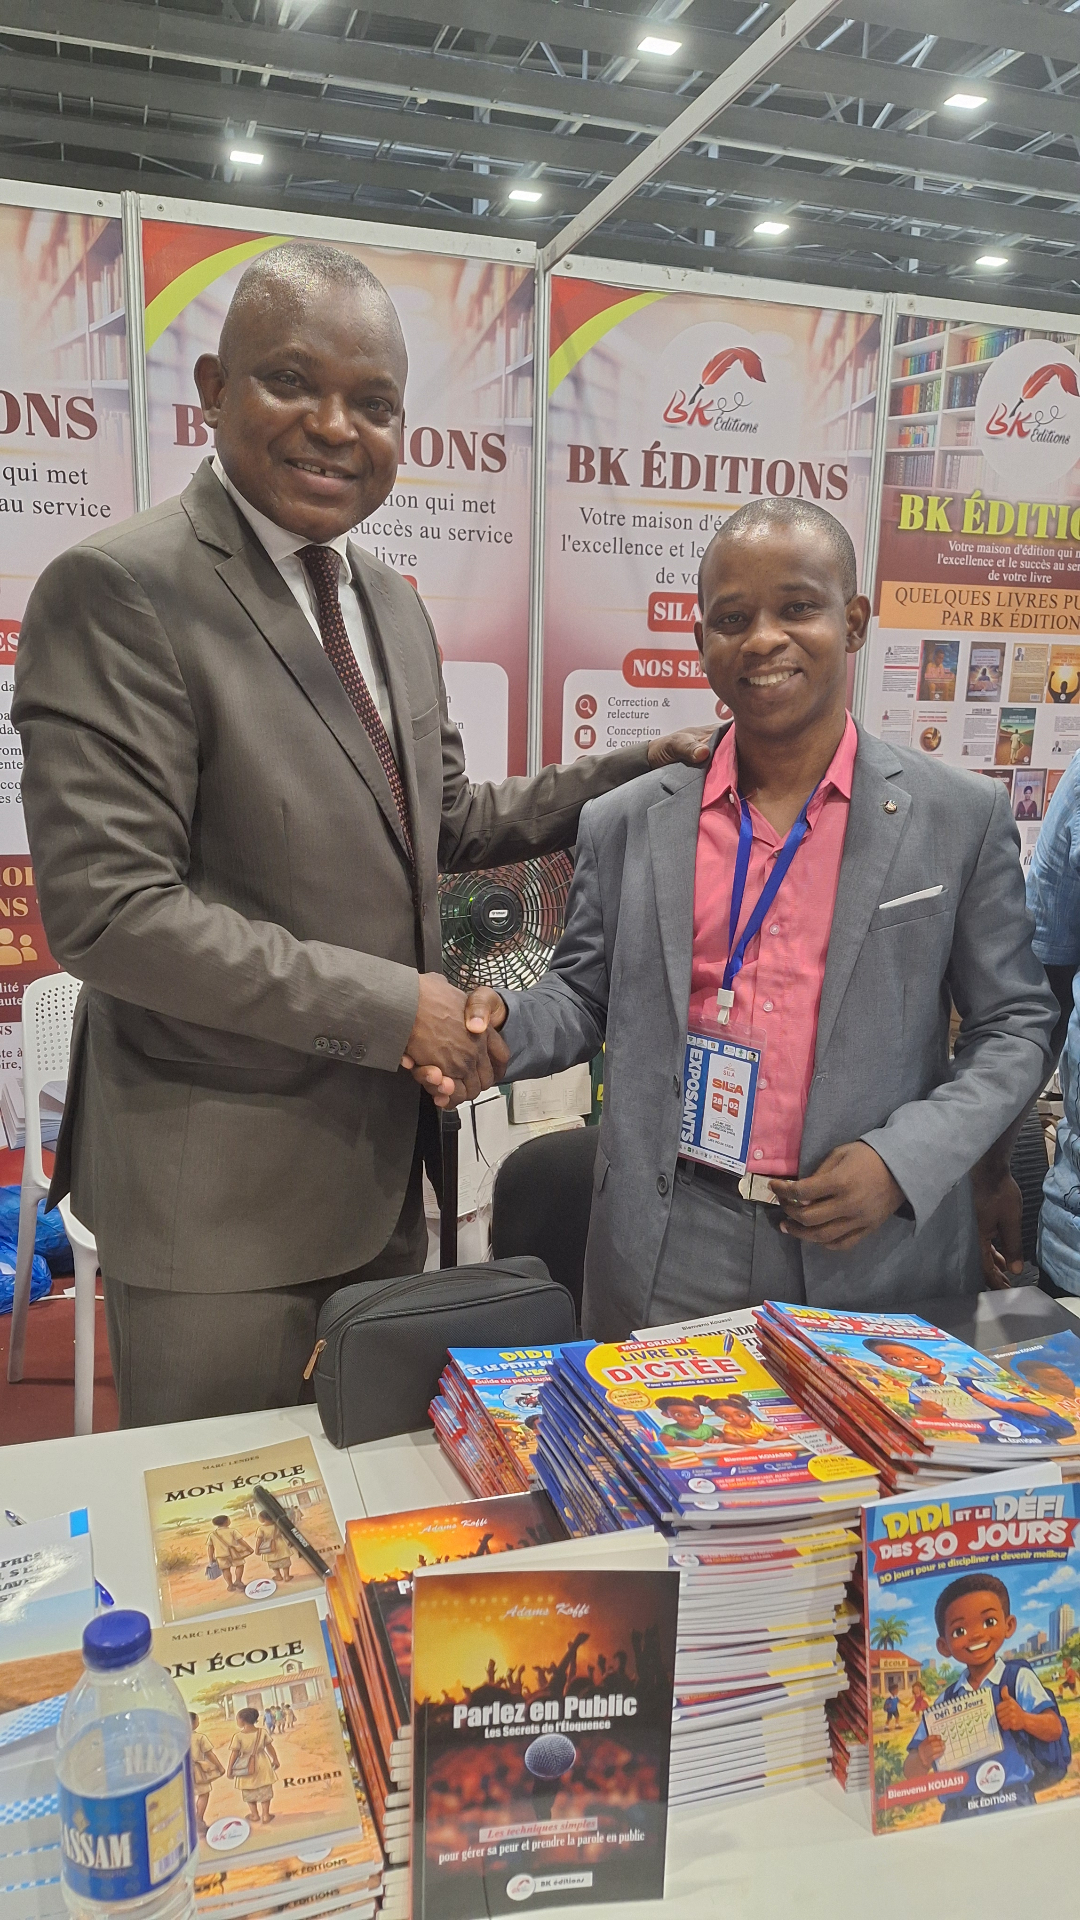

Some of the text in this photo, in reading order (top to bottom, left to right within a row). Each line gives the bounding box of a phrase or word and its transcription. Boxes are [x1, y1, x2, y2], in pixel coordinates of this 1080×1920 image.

[2, 462, 89, 486] qui met
[566, 440, 849, 501] BK ÉDITIONS
[32, 497, 112, 518] service
[425, 494, 455, 515] qui
[463, 499, 497, 515] met
[898, 493, 953, 533] BK
[579, 506, 723, 532] Votre maison d'é
[351, 518, 513, 544] succès au service
[561, 534, 663, 557] l'excellence
[669, 542, 685, 558] et
[948, 540, 1073, 561] Votre maison d'édition qui
[937, 552, 994, 567] l'excellence
[996, 558, 1006, 568] et
[1008, 558, 1018, 569] le
[1019, 558, 1051, 570] succès
[1053, 563, 1065, 572] au
[655, 567, 675, 584] de
[988, 569, 1053, 584] de votre livre
[895, 586, 1058, 609] QUELQUES LIVRES
[941, 609, 975, 627] PAR
[980, 612, 1005, 628] BK
[632, 659, 708, 678] NOS SE
[607, 696, 671, 708] Correction &
[607, 709, 650, 719] relecture
[606, 725, 661, 738] Conception
[606, 738, 618, 748] de
[680, 1047, 704, 1144] EXPOSANTS
[711, 1077, 745, 1097] SILA
[728, 1101, 739, 1111] 02
[620, 1337, 682, 1352] MON GRAND
[498, 1349, 554, 1363] DIDI
[619, 1347, 702, 1363] LIVRE DE
[467, 1359, 539, 1376] ET LE PETIT
[606, 1356, 742, 1383] DICTÉE
[474, 1376, 531, 1386] Guide du petit
[202, 1455, 260, 1471] MARC LENDES
[164, 1464, 306, 1504] MON ÉCOLE
[883, 1488, 1066, 1541] DIDI ET LE DÉFI
[420, 1517, 489, 1535] Adams Koffi
[879, 1519, 1070, 1562] DES 30 JOURS
[879, 1547, 1068, 1585] 30 jours pour se discipliner et devenir meilleur
[502, 1602, 591, 1620] Adams Koffi
[171, 1623, 248, 1642] MARC LENDES
[206, 1640, 305, 1674] ÉCOLE
[883, 1659, 909, 1668] ÉCOLE
[452, 1693, 638, 1730] Parlez en Public
[933, 1698, 984, 1721] Défi 30 Jours
[484, 1717, 612, 1740] Les Secrets de l'Éloquence
[282, 1769, 343, 1789] Roman
[887, 1786, 927, 1800] Bienvenu
[928, 1775, 965, 1793] KOUASSI
[967, 1792, 1018, 1811] BK ÉDITIONS
[487, 1818, 597, 1841] Les techniques simples
[438, 1828, 646, 1866] pour gérer sa peur et prendre la parole en public
[540, 1876, 586, 1888] BK éditions
